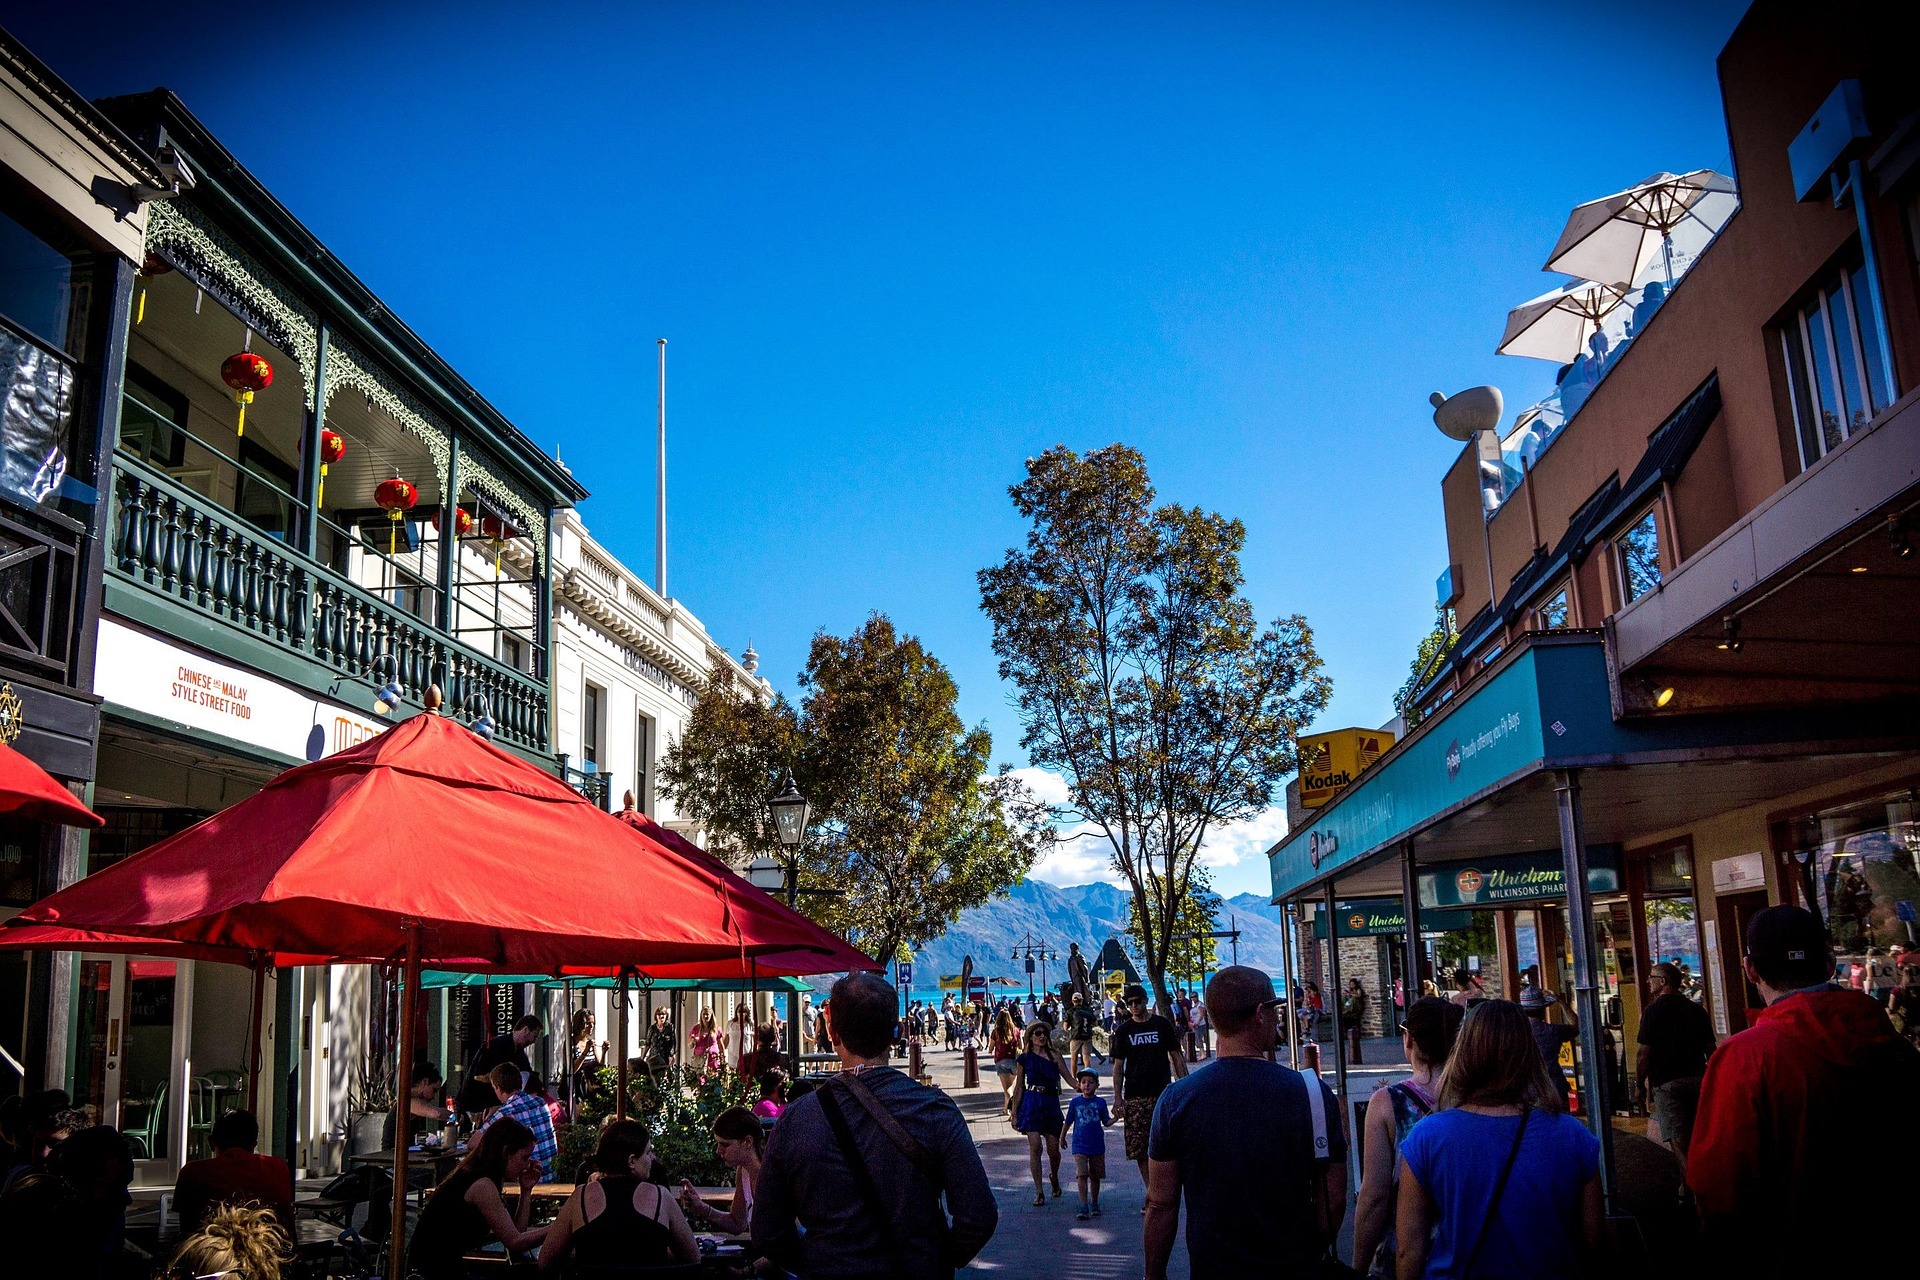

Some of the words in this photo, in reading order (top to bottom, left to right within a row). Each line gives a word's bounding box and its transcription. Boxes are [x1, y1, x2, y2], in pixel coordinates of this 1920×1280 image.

[178, 666, 212, 690] CHINESE
[222, 681, 248, 701] MALAY
[171, 682, 198, 703] STYLE
[199, 691, 230, 713] STREET
[231, 702, 251, 720] FOOD
[1304, 770, 1351, 791] Kodak
[1489, 866, 1561, 888] Unichem
[1488, 886, 1540, 899] WILKINSONS
[1542, 882, 1568, 894] PHAR
[1368, 926, 1400, 934] WILKINSONS
[1128, 1031, 1159, 1046] VANS
